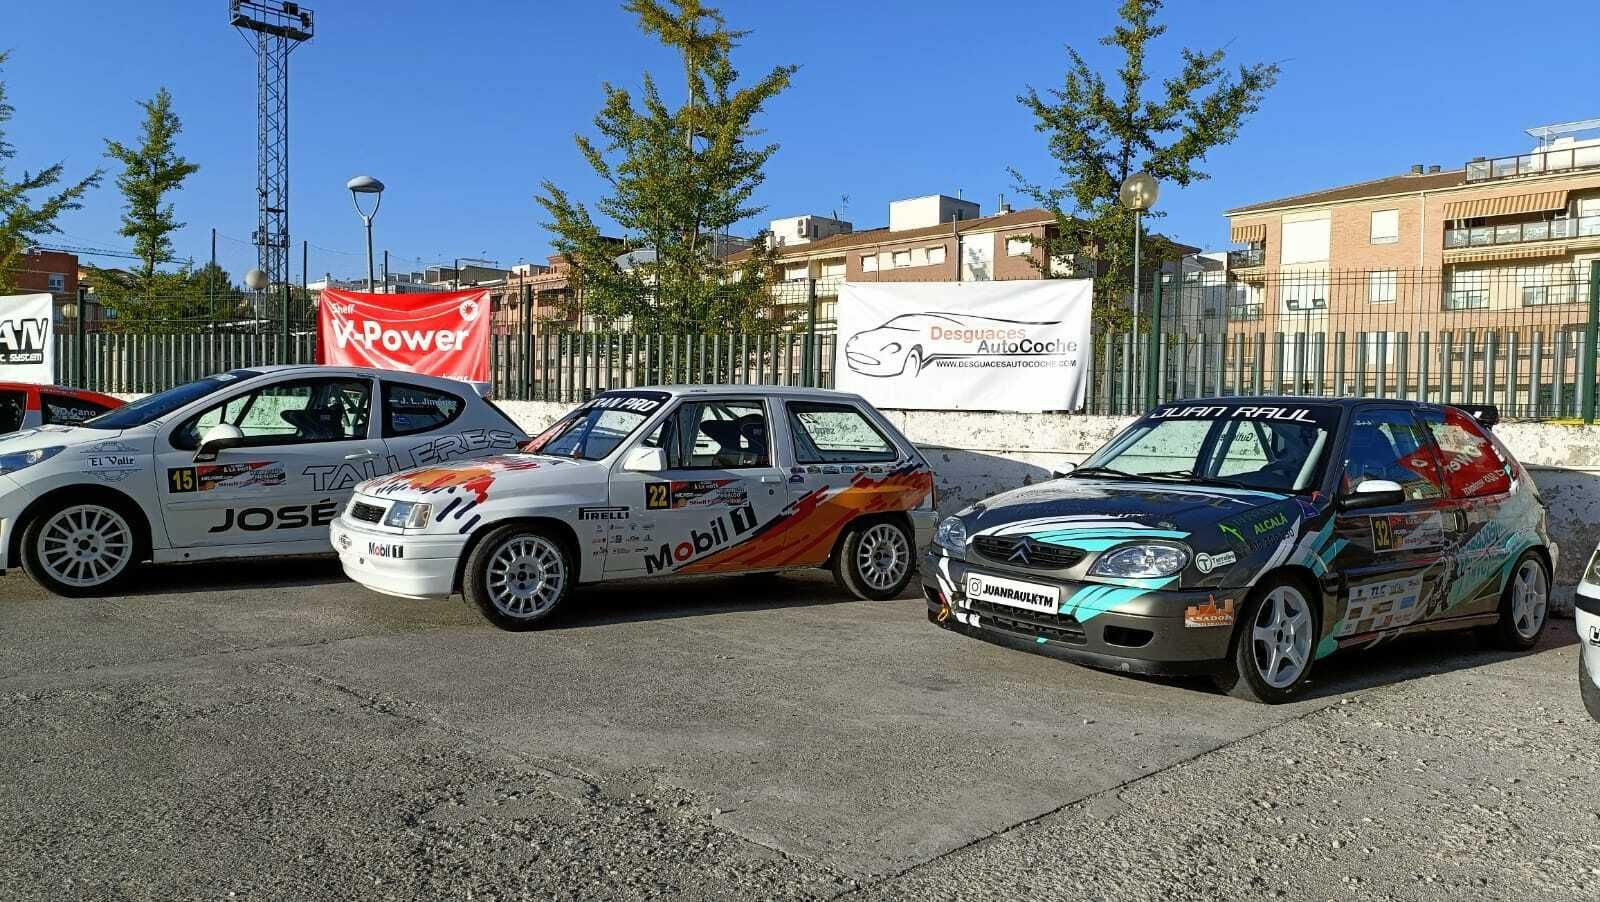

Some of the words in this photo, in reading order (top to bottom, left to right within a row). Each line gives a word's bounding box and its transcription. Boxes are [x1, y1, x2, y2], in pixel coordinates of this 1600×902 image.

[331, 303, 355, 314] Shell
[331, 320, 471, 352] V-Power
[931, 326, 1026, 345] Desguaces
[977, 338, 1077, 354] AutoCoche
[935, 359, 1077, 369] WWW.DESGUACESAUTOCOCHE.COM
[617, 398, 660, 412] PRO
[1150, 406, 1228, 419] JUAN
[1232, 406, 1317, 424] RAUL
[303, 428, 519, 491] TALLERES
[173, 470, 193, 490] 15
[649, 485, 667, 507] 22
[208, 498, 338, 533] JOSÉ
[578, 506, 630, 521] PIRELLI
[1375, 519, 1391, 546] 32
[368, 542, 390, 558] Mobil
[644, 516, 728, 575] Mobil
[983, 583, 1053, 608] JUANRAULKTM
